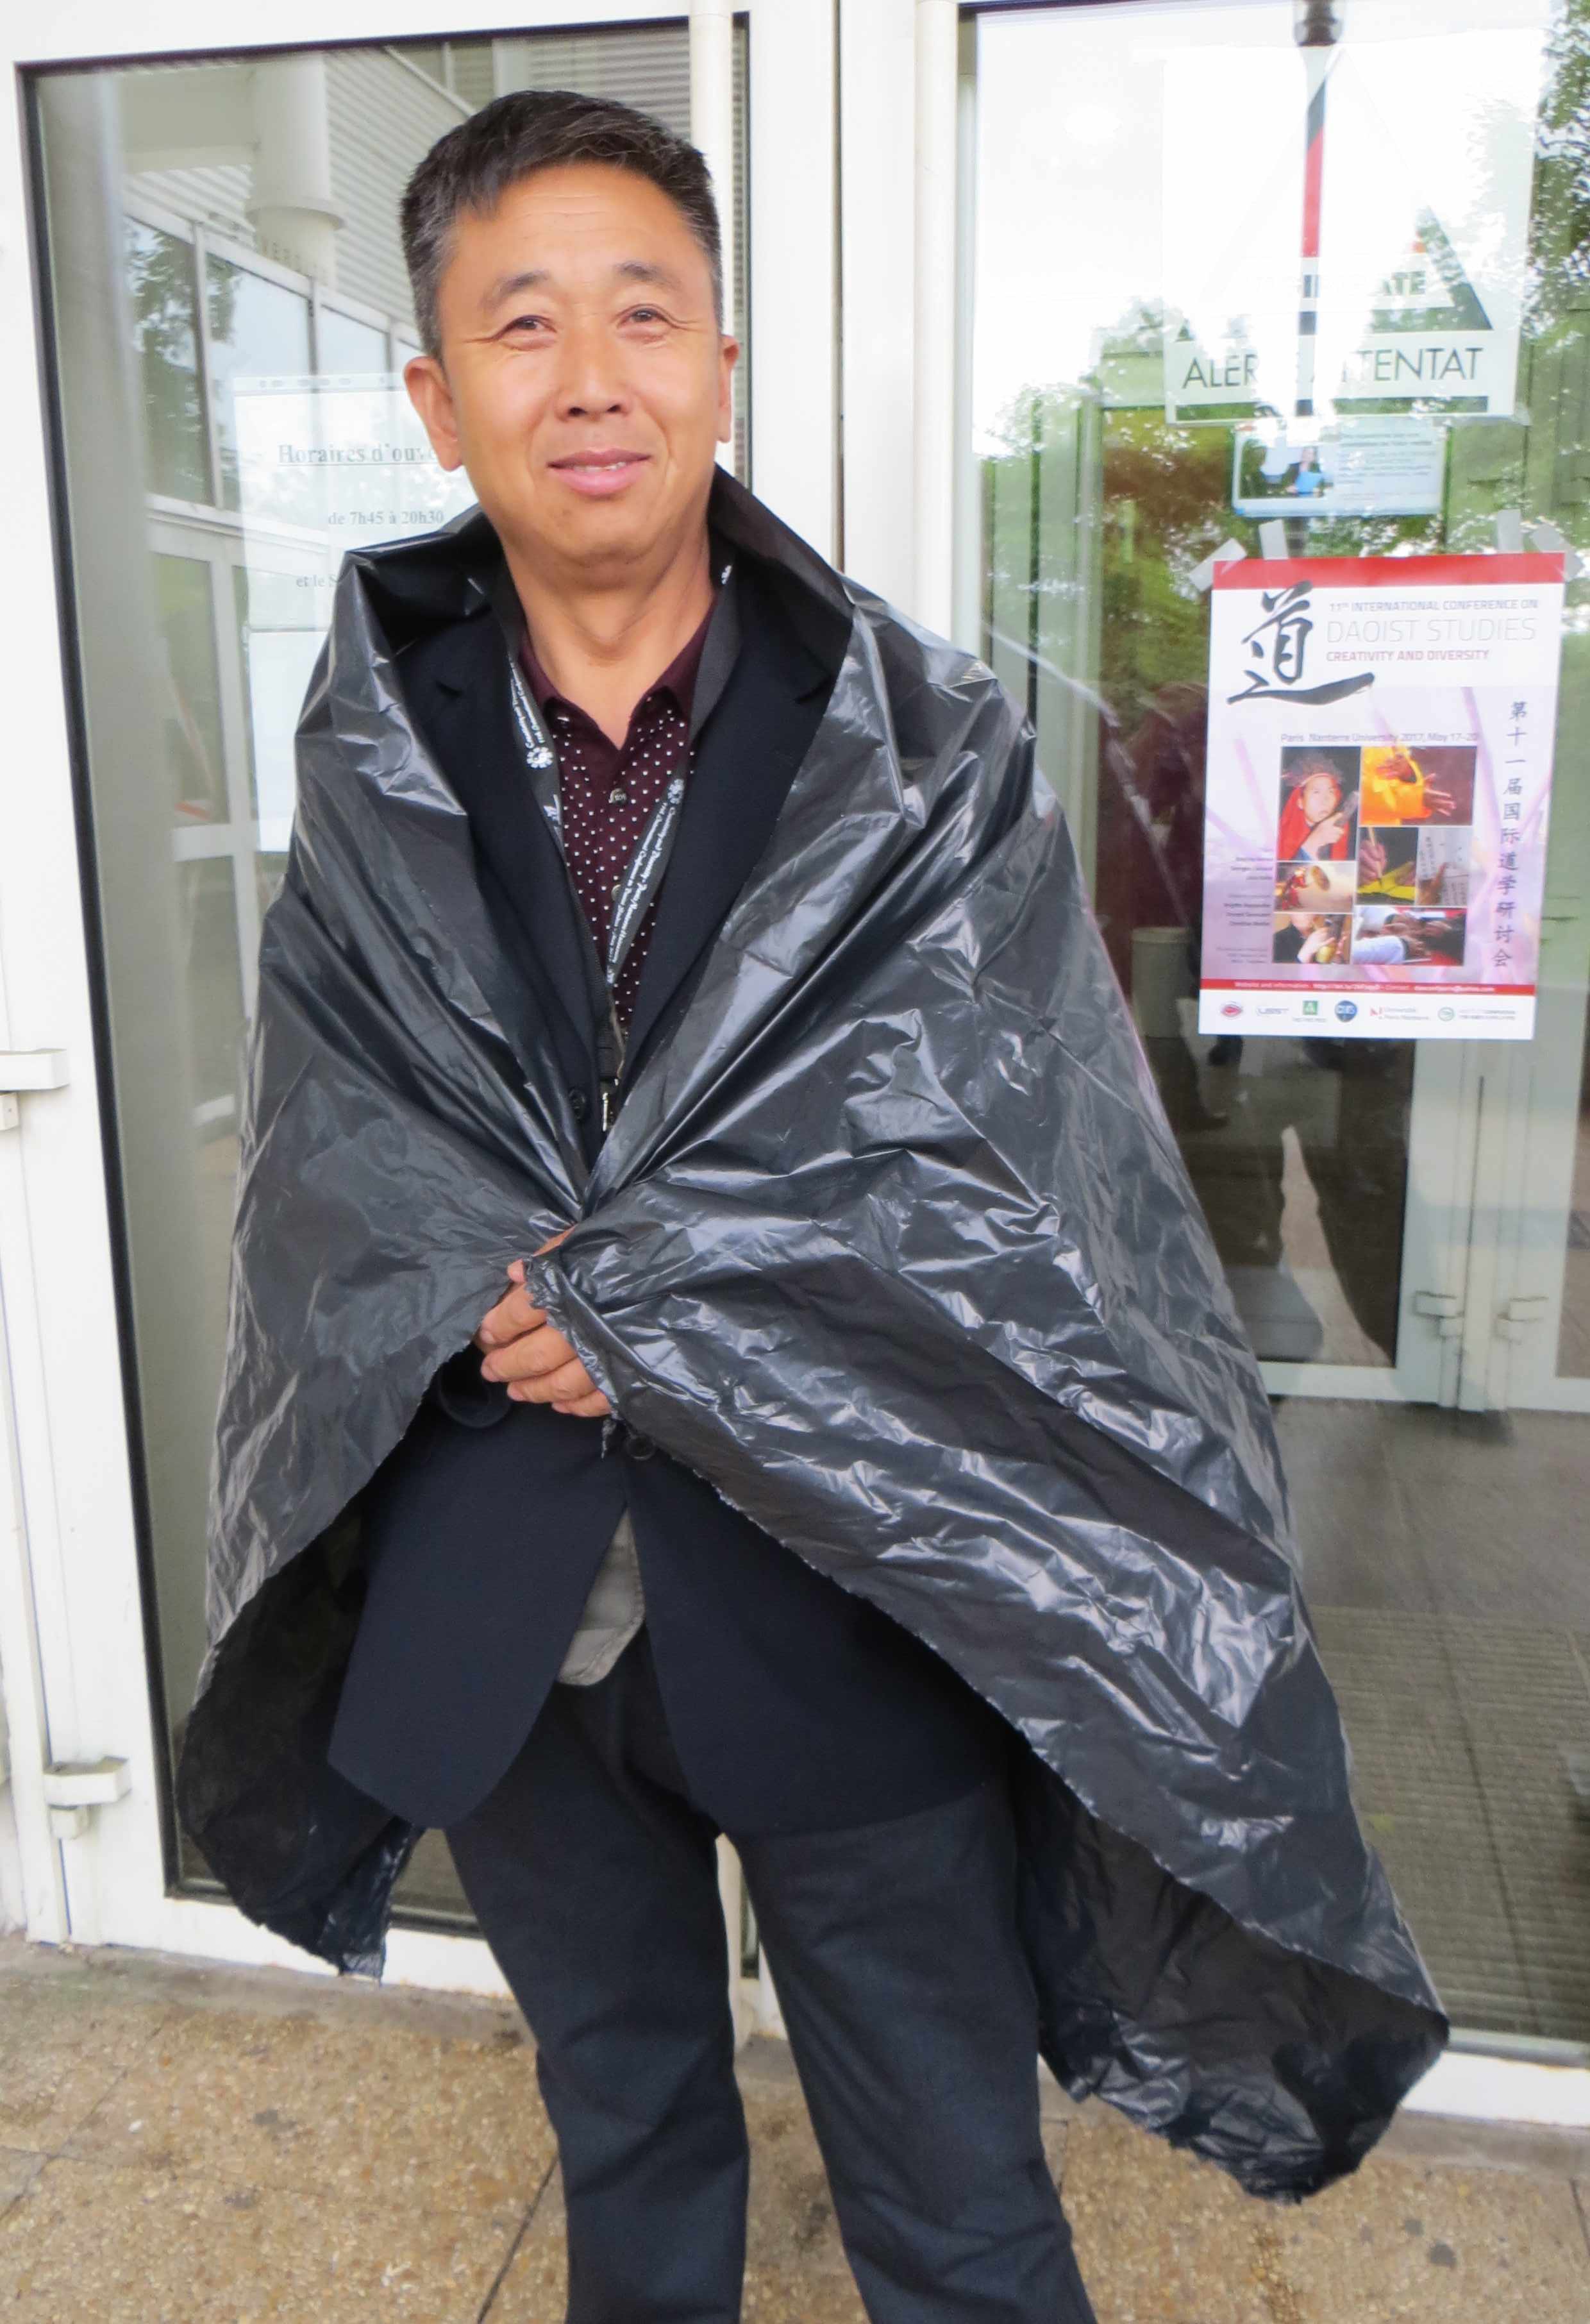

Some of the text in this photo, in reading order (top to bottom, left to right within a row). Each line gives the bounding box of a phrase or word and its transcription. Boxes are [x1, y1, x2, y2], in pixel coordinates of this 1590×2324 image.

[1182, 348, 1484, 389] ALER TENTAT
[278, 444, 365, 462] Horaires
[328, 511, 444, 525] de 7h45 à 20h30
[1352, 601, 1440, 612] INTERNATIONAL
[1443, 599, 1519, 610] CONFERENCE
[1521, 598, 1539, 609] ON
[1326, 618, 1538, 643] DAOIST STUDIES
[1228, 580, 1375, 705] 道
[1326, 649, 1489, 662] CREATIVITY AND DIVERSITY
